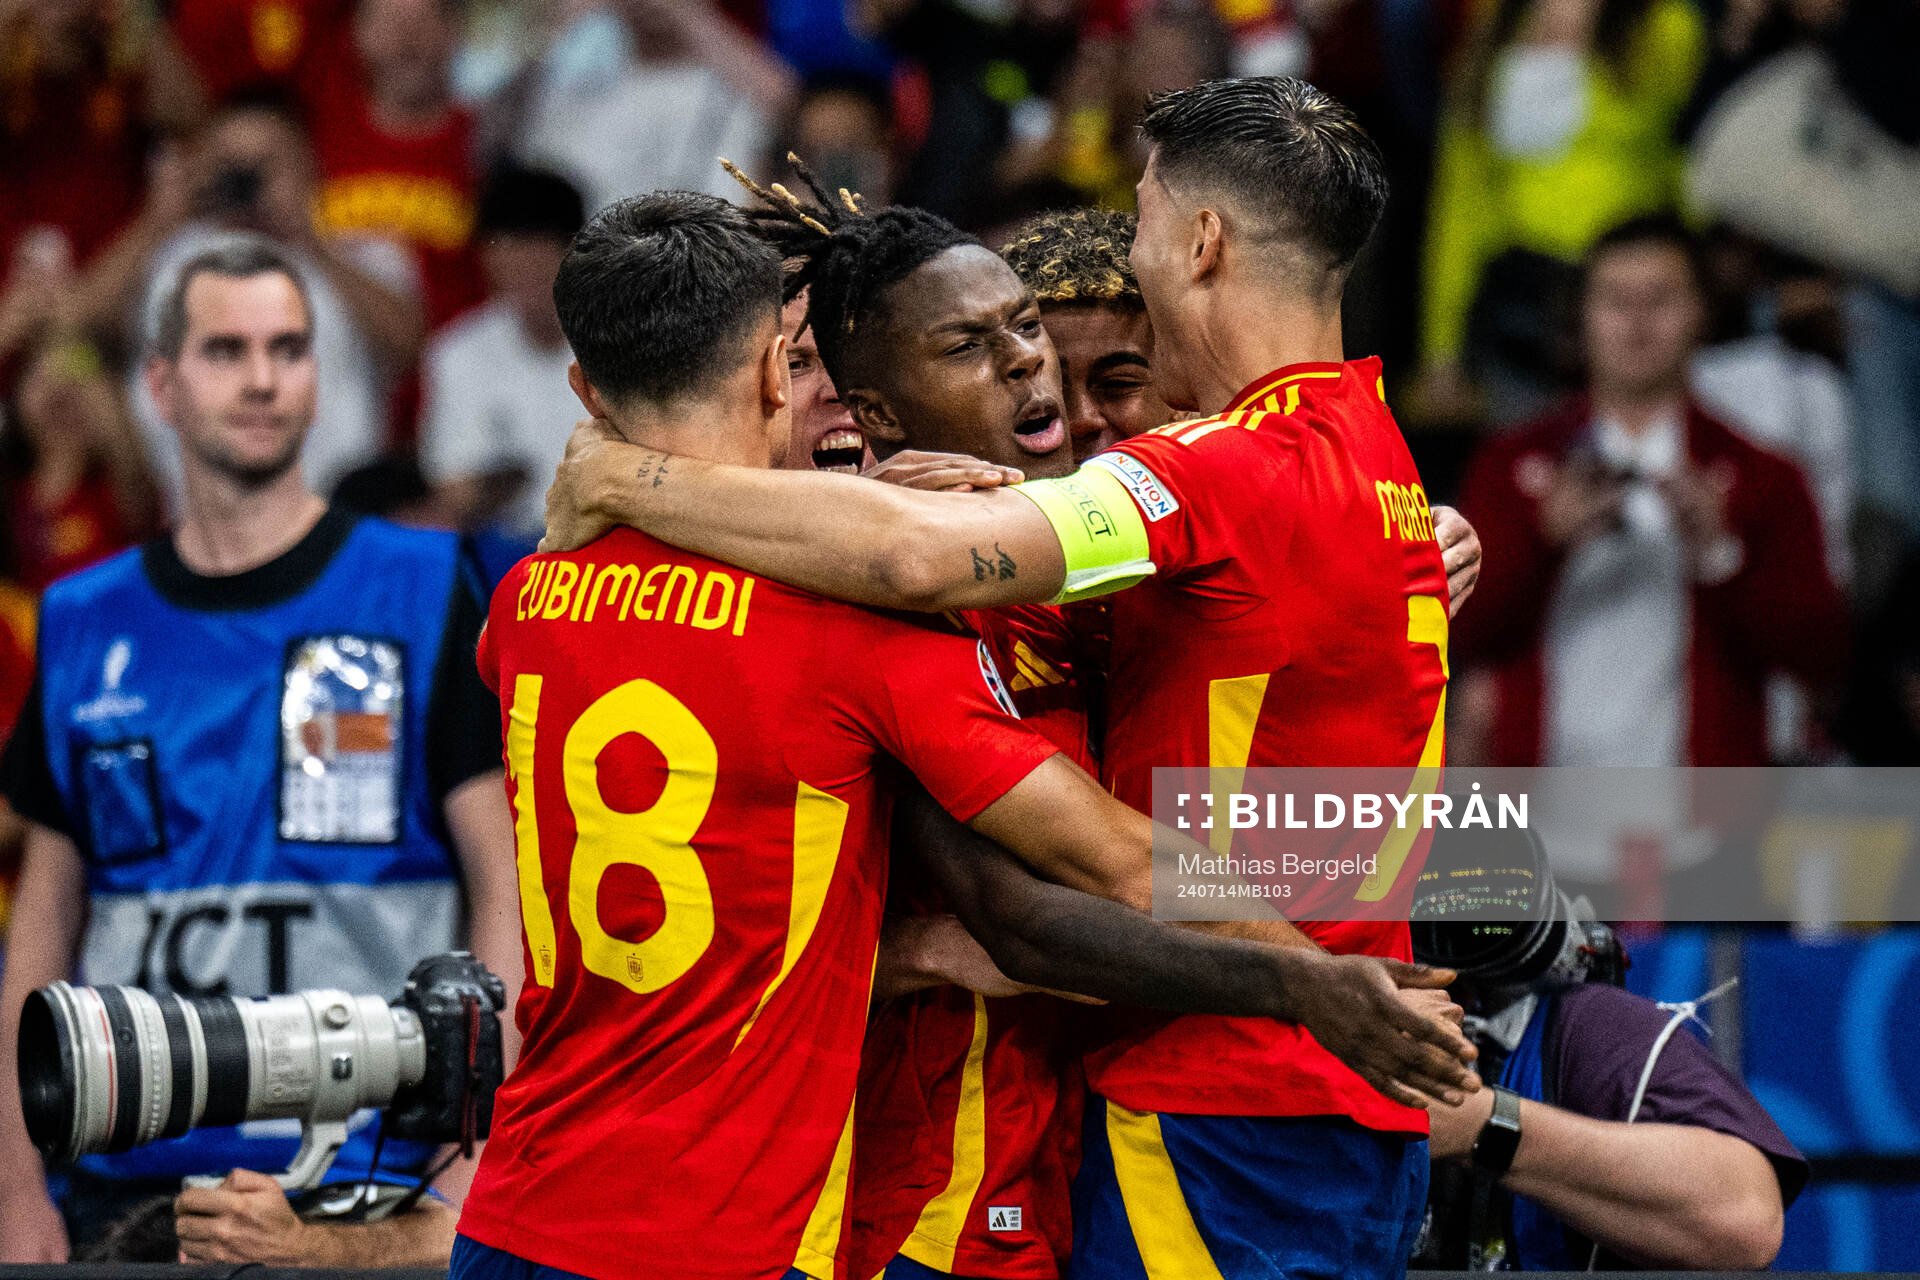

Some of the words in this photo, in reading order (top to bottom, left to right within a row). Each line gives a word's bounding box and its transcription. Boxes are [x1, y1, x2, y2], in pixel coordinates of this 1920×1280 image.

[516, 560, 756, 637] ZUBIMENDI
[507, 673, 719, 995] 18
[137, 902, 313, 996] ICT
